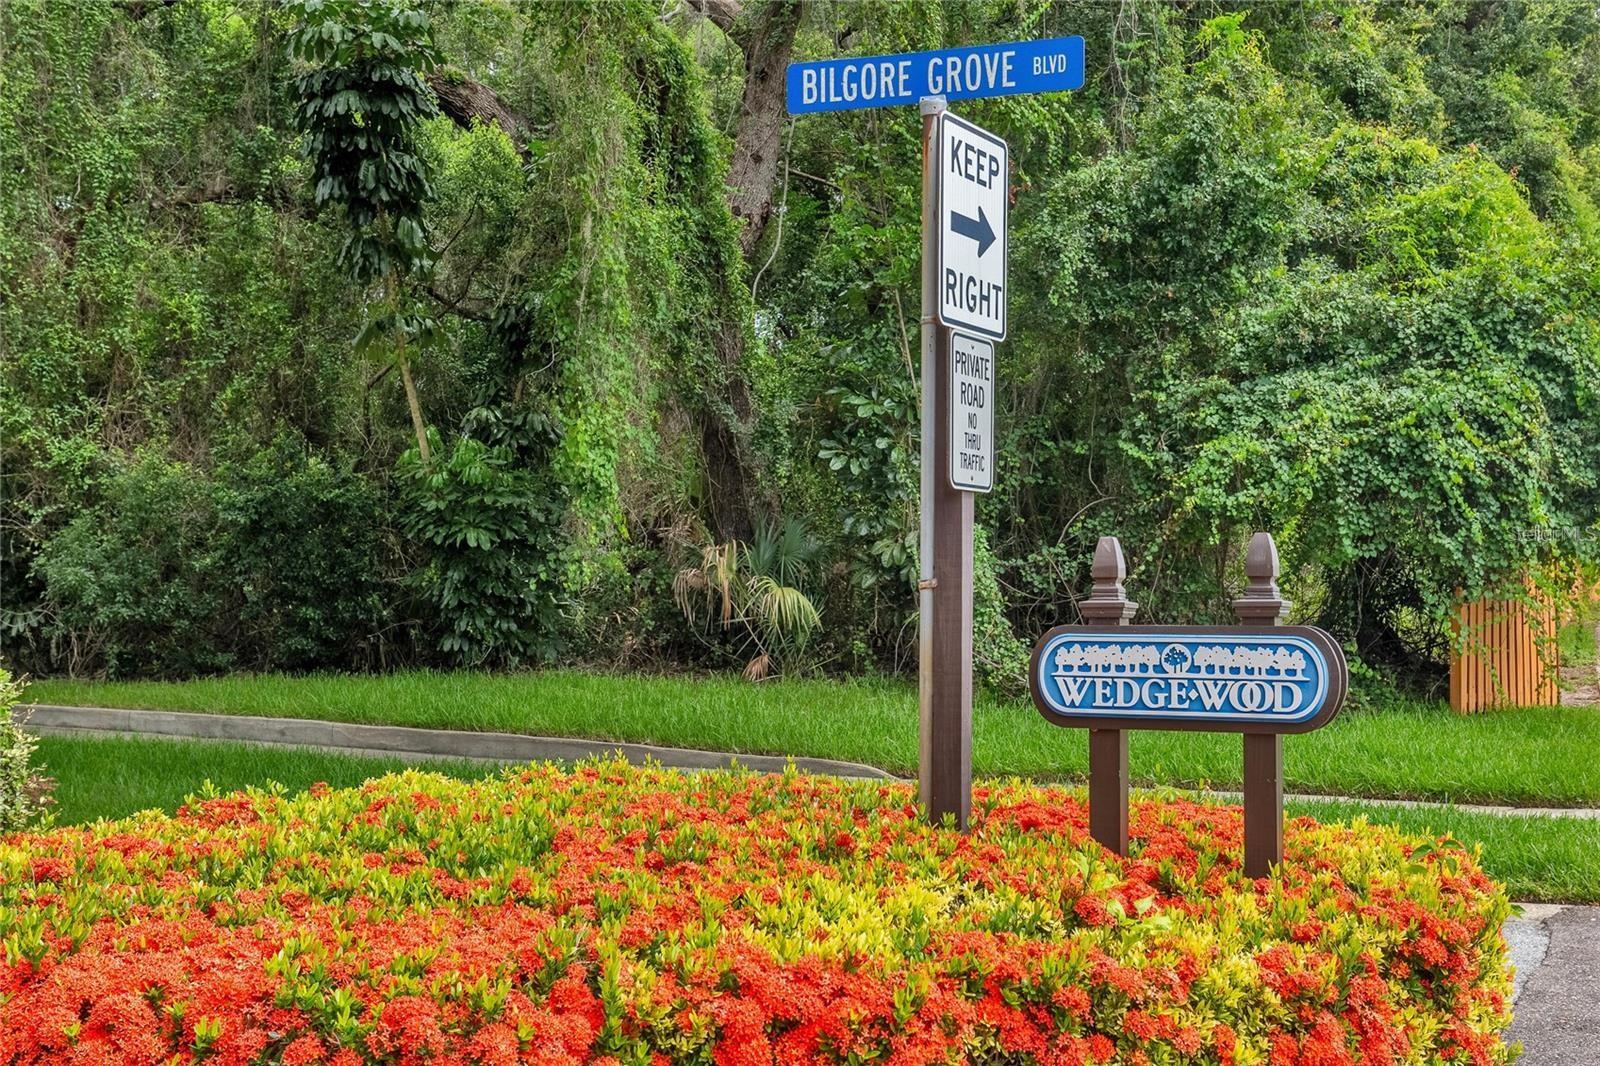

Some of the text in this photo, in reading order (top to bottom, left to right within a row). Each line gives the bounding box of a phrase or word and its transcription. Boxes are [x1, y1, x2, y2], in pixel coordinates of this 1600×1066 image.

[802, 50, 1067, 105] BILGORE GROVE BLVD
[951, 136, 1000, 190] KEEP
[945, 268, 1002, 320] RIGHT
[955, 351, 990, 381] PRIVATE
[960, 381, 985, 409] ROAD
[967, 412, 977, 430] NO
[964, 432, 981, 451] THRU
[960, 452, 985, 472] TRAFFIC
